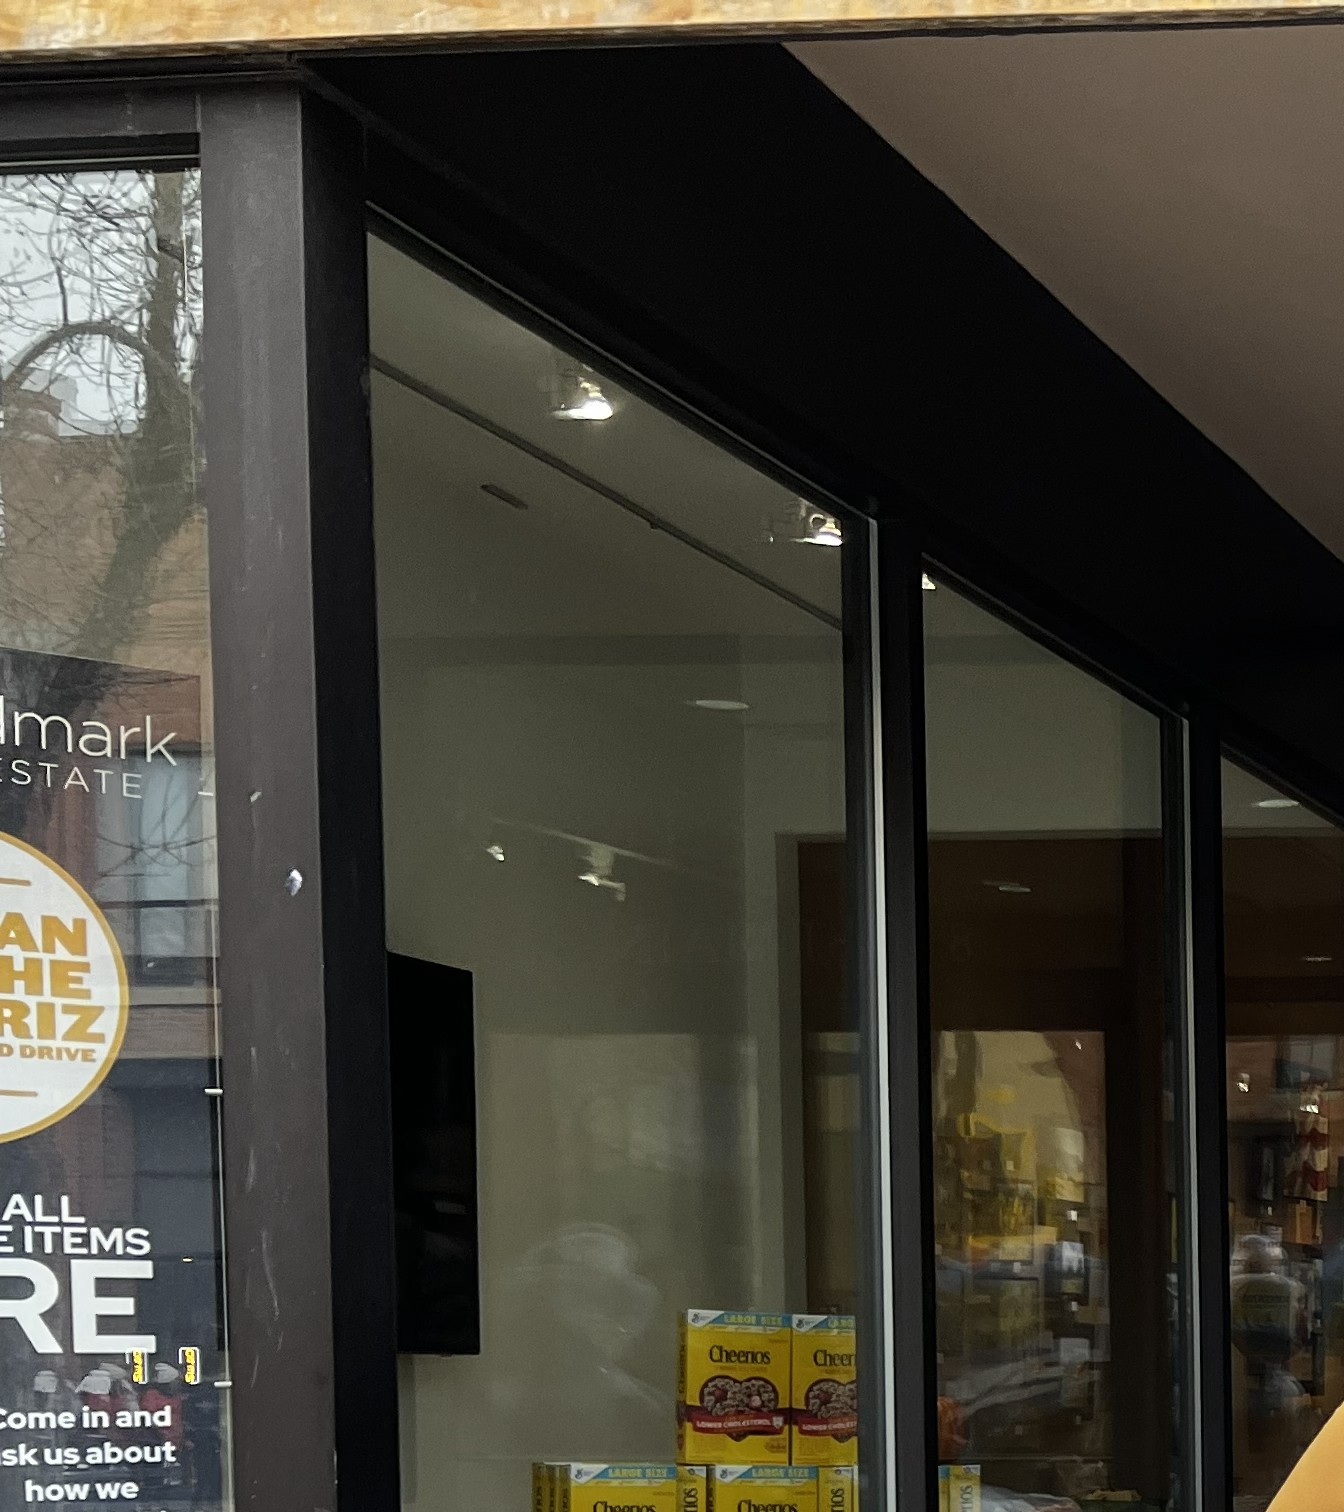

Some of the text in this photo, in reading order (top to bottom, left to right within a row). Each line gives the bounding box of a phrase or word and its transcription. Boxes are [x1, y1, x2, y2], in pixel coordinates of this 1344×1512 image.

[0, 695, 178, 767] mark
[0, 758, 143, 800] STATE
[0, 912, 88, 957] AN
[19, 1045, 97, 1063] DRIVE
[3, 1194, 86, 1223] ALL
[24, 1227, 151, 1256] ITEMS
[0, 1257, 157, 1355] RE
[709, 1344, 771, 1365] Cheerios
[0, 1405, 172, 1431] Come in and
[0, 1441, 176, 1467] sk us about
[24, 1479, 140, 1503] how we
